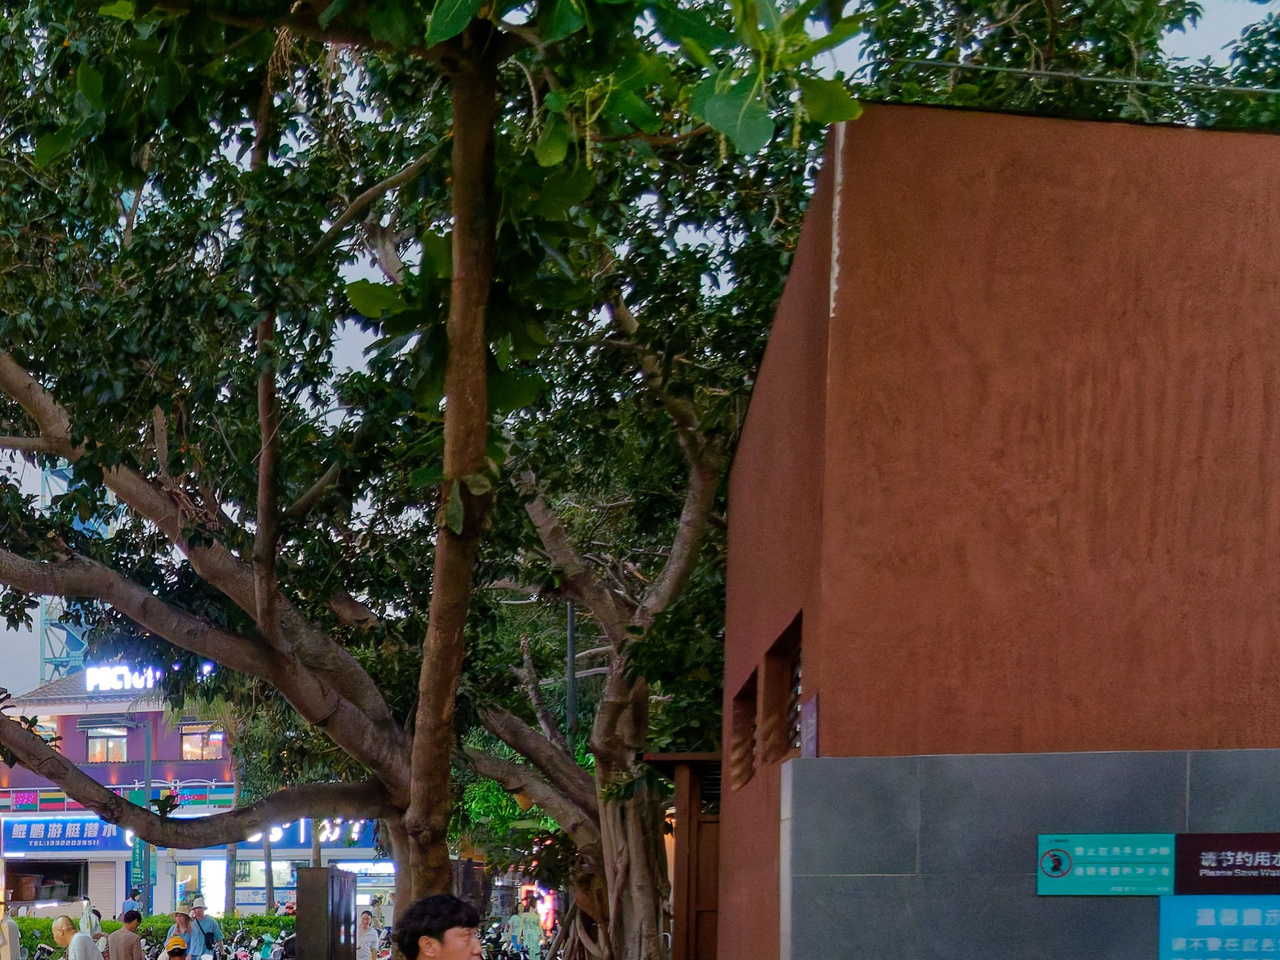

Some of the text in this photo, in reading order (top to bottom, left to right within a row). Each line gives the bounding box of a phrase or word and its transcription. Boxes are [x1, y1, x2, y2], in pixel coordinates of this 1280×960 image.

[11, 822, 117, 839] 鲲鹏游艇潜水
[1234, 869, 1259, 877] Save
